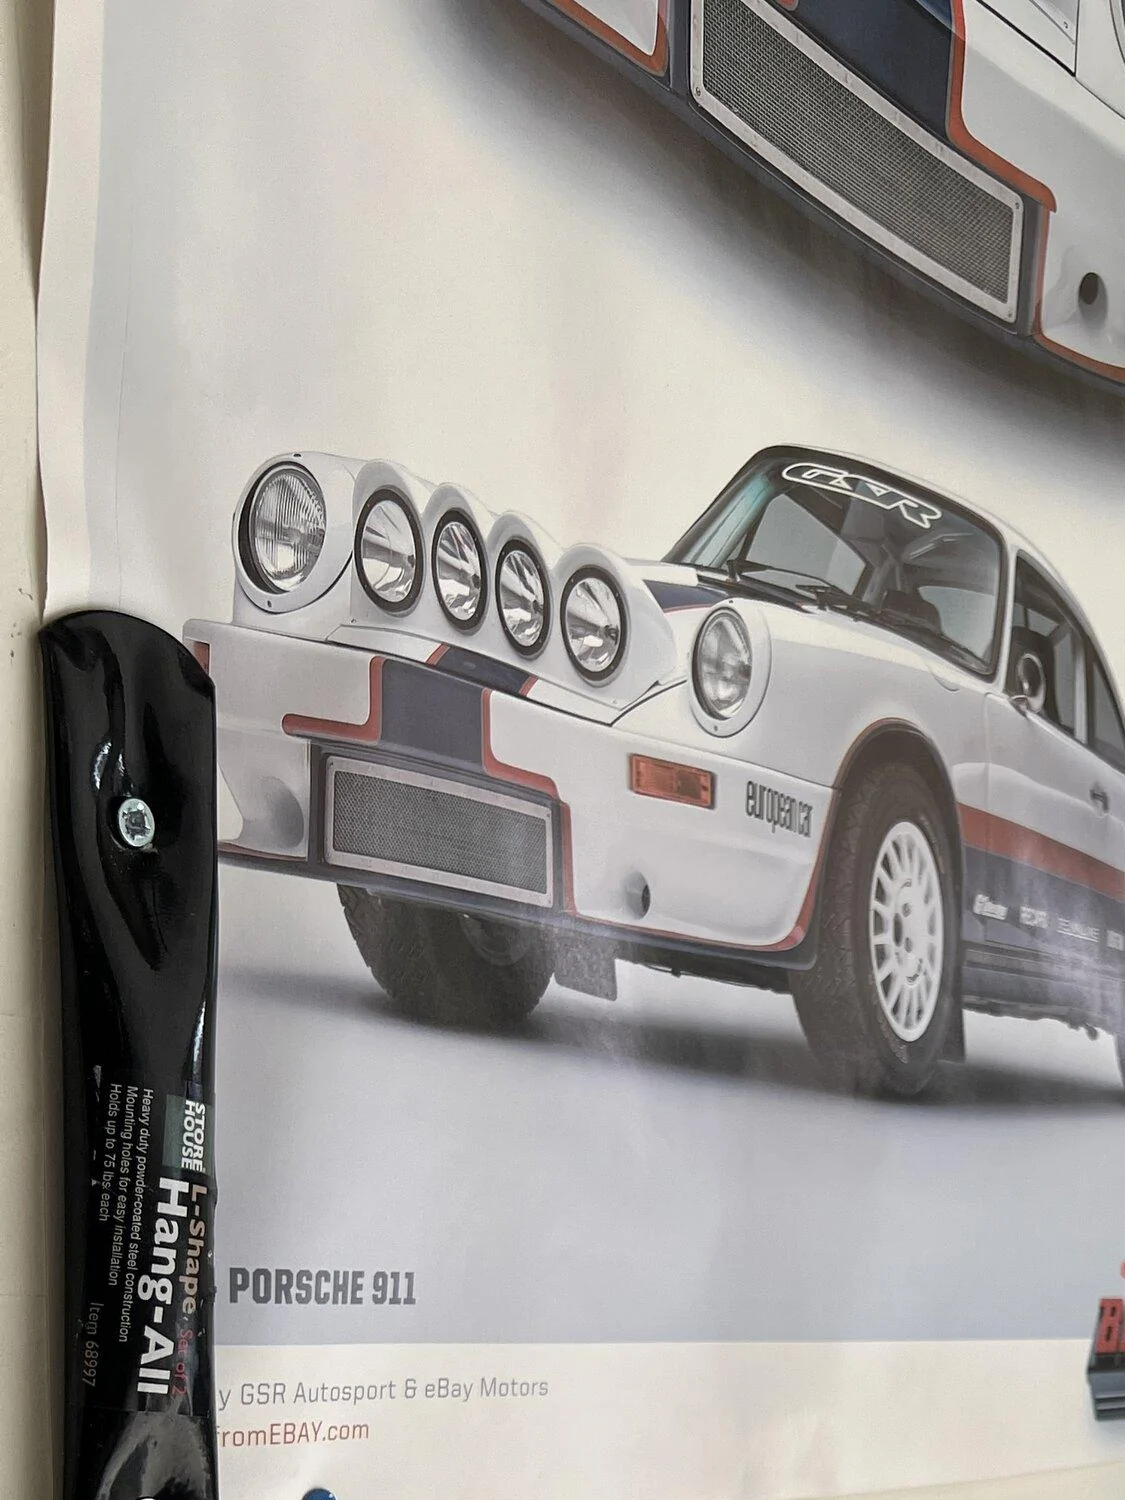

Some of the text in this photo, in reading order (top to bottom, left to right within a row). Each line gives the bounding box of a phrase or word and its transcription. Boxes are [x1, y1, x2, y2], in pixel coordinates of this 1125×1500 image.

[108, 1083, 122, 1117] Holds
[105, 1121, 116, 1135] up
[105, 1138, 116, 1149] to
[181, 1100, 195, 1169] HOUSE
[193, 1102, 206, 1172] STORE
[103, 1153, 116, 1168] 75
[108, 1085, 138, 1286] Mounting holes for easy installation
[99, 1193, 111, 1221] each
[119, 1088, 154, 1342] Heavy duty powder-coated steel construction
[179, 1184, 207, 1315] L-Shape
[137, 1177, 189, 1394] Hang-All
[229, 1266, 417, 1305] PORSCHE 911
[81, 1302, 104, 1387] Item 68997
[171, 1328, 193, 1398] Set of 2
[241, 1383, 286, 1406] GSR
[293, 1379, 396, 1408] Autosport
[405, 1378, 417, 1399] &
[425, 1377, 474, 1402] eBay
[480, 1377, 549, 1398] Motors
[216, 1421, 369, 1448] romEBAY.com
